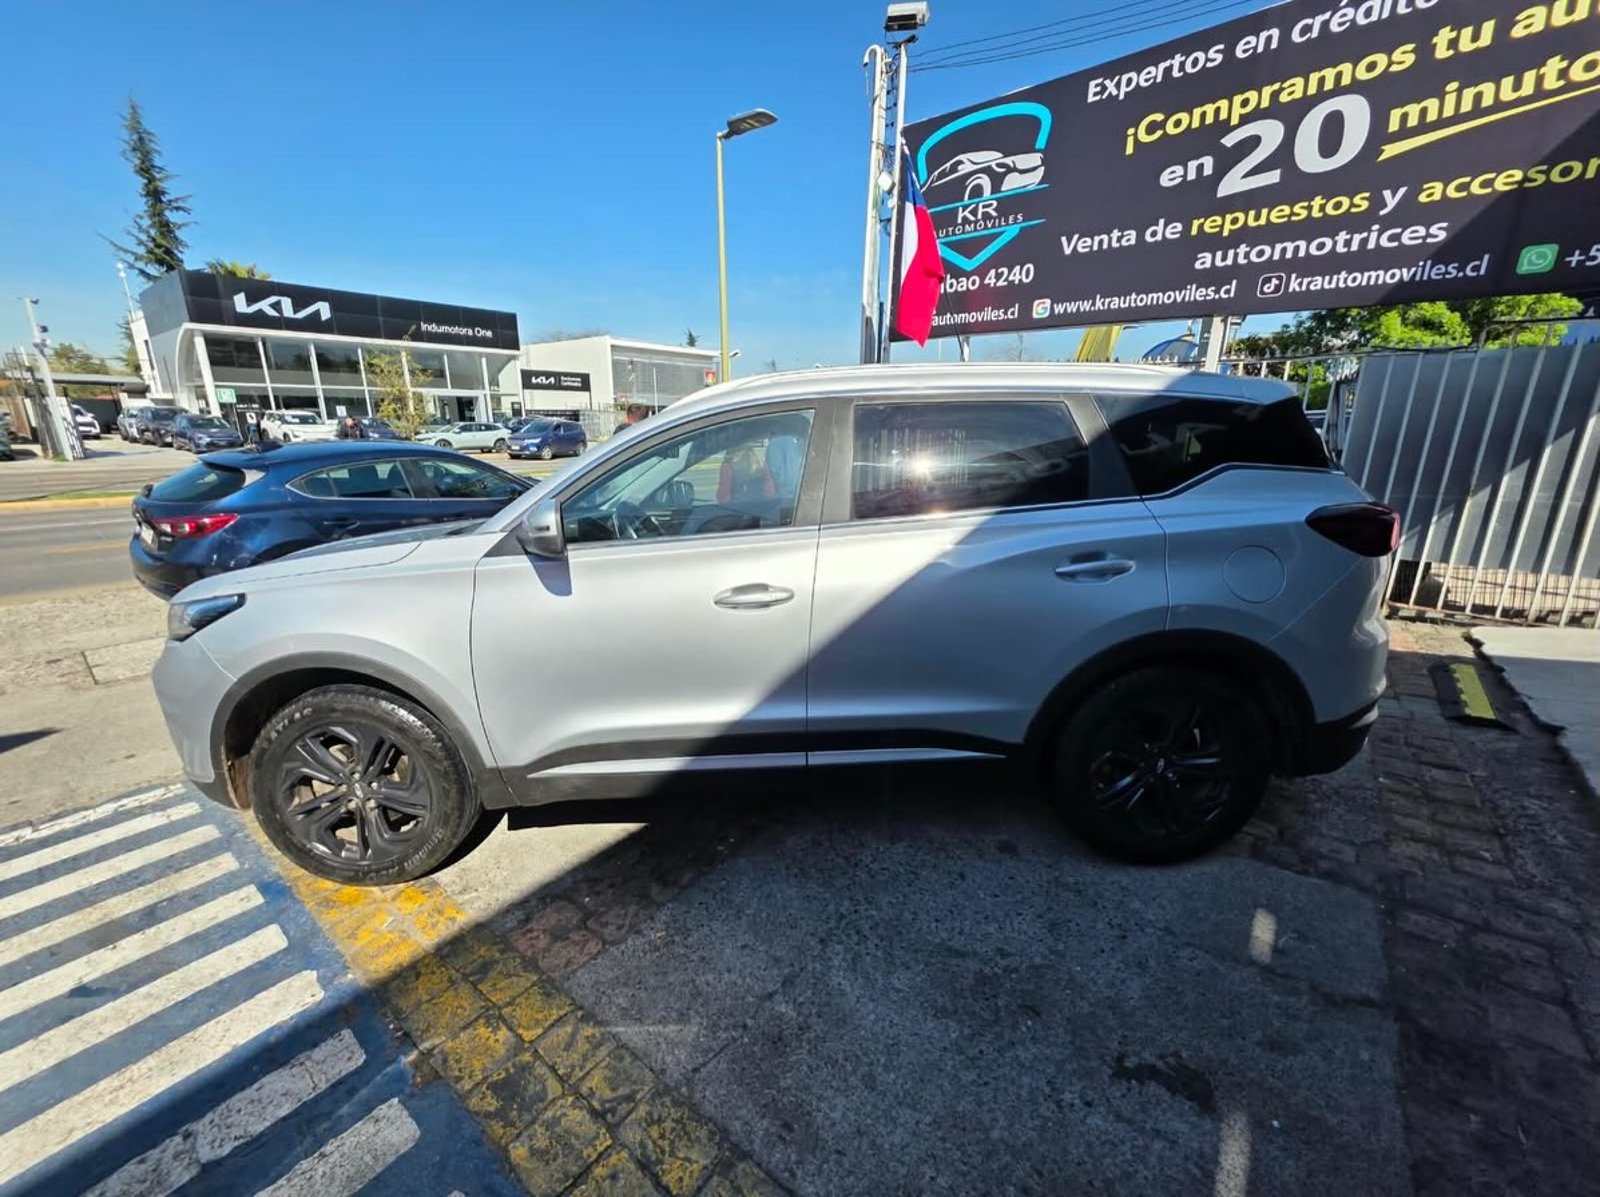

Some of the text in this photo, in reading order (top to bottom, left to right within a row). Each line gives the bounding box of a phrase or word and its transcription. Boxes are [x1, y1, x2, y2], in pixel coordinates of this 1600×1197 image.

[1087, 42, 1224, 103] Expertos
[1235, 26, 1280, 58] en
[1124, 0, 1600, 156] ¡Compramos tu au
[1159, 50, 1600, 198] en 20 minuto
[934, 213, 1024, 238] UTOMÓVILES
[957, 199, 999, 224] KR
[1060, 226, 1137, 255] Venta
[1144, 218, 1182, 243] de
[1190, 191, 1371, 237] repuestos
[1379, 186, 1408, 216] y
[1194, 221, 1449, 270] automotrices
[983, 263, 1035, 288] 4240
[1288, 254, 1490, 293] krautomoviles.cl
[233, 291, 331, 322] KIA
[931, 303, 1019, 327] automoviles.cl
[1053, 279, 1237, 315] www.krautomoviles.cl
[420, 321, 493, 338] Indumotora One
